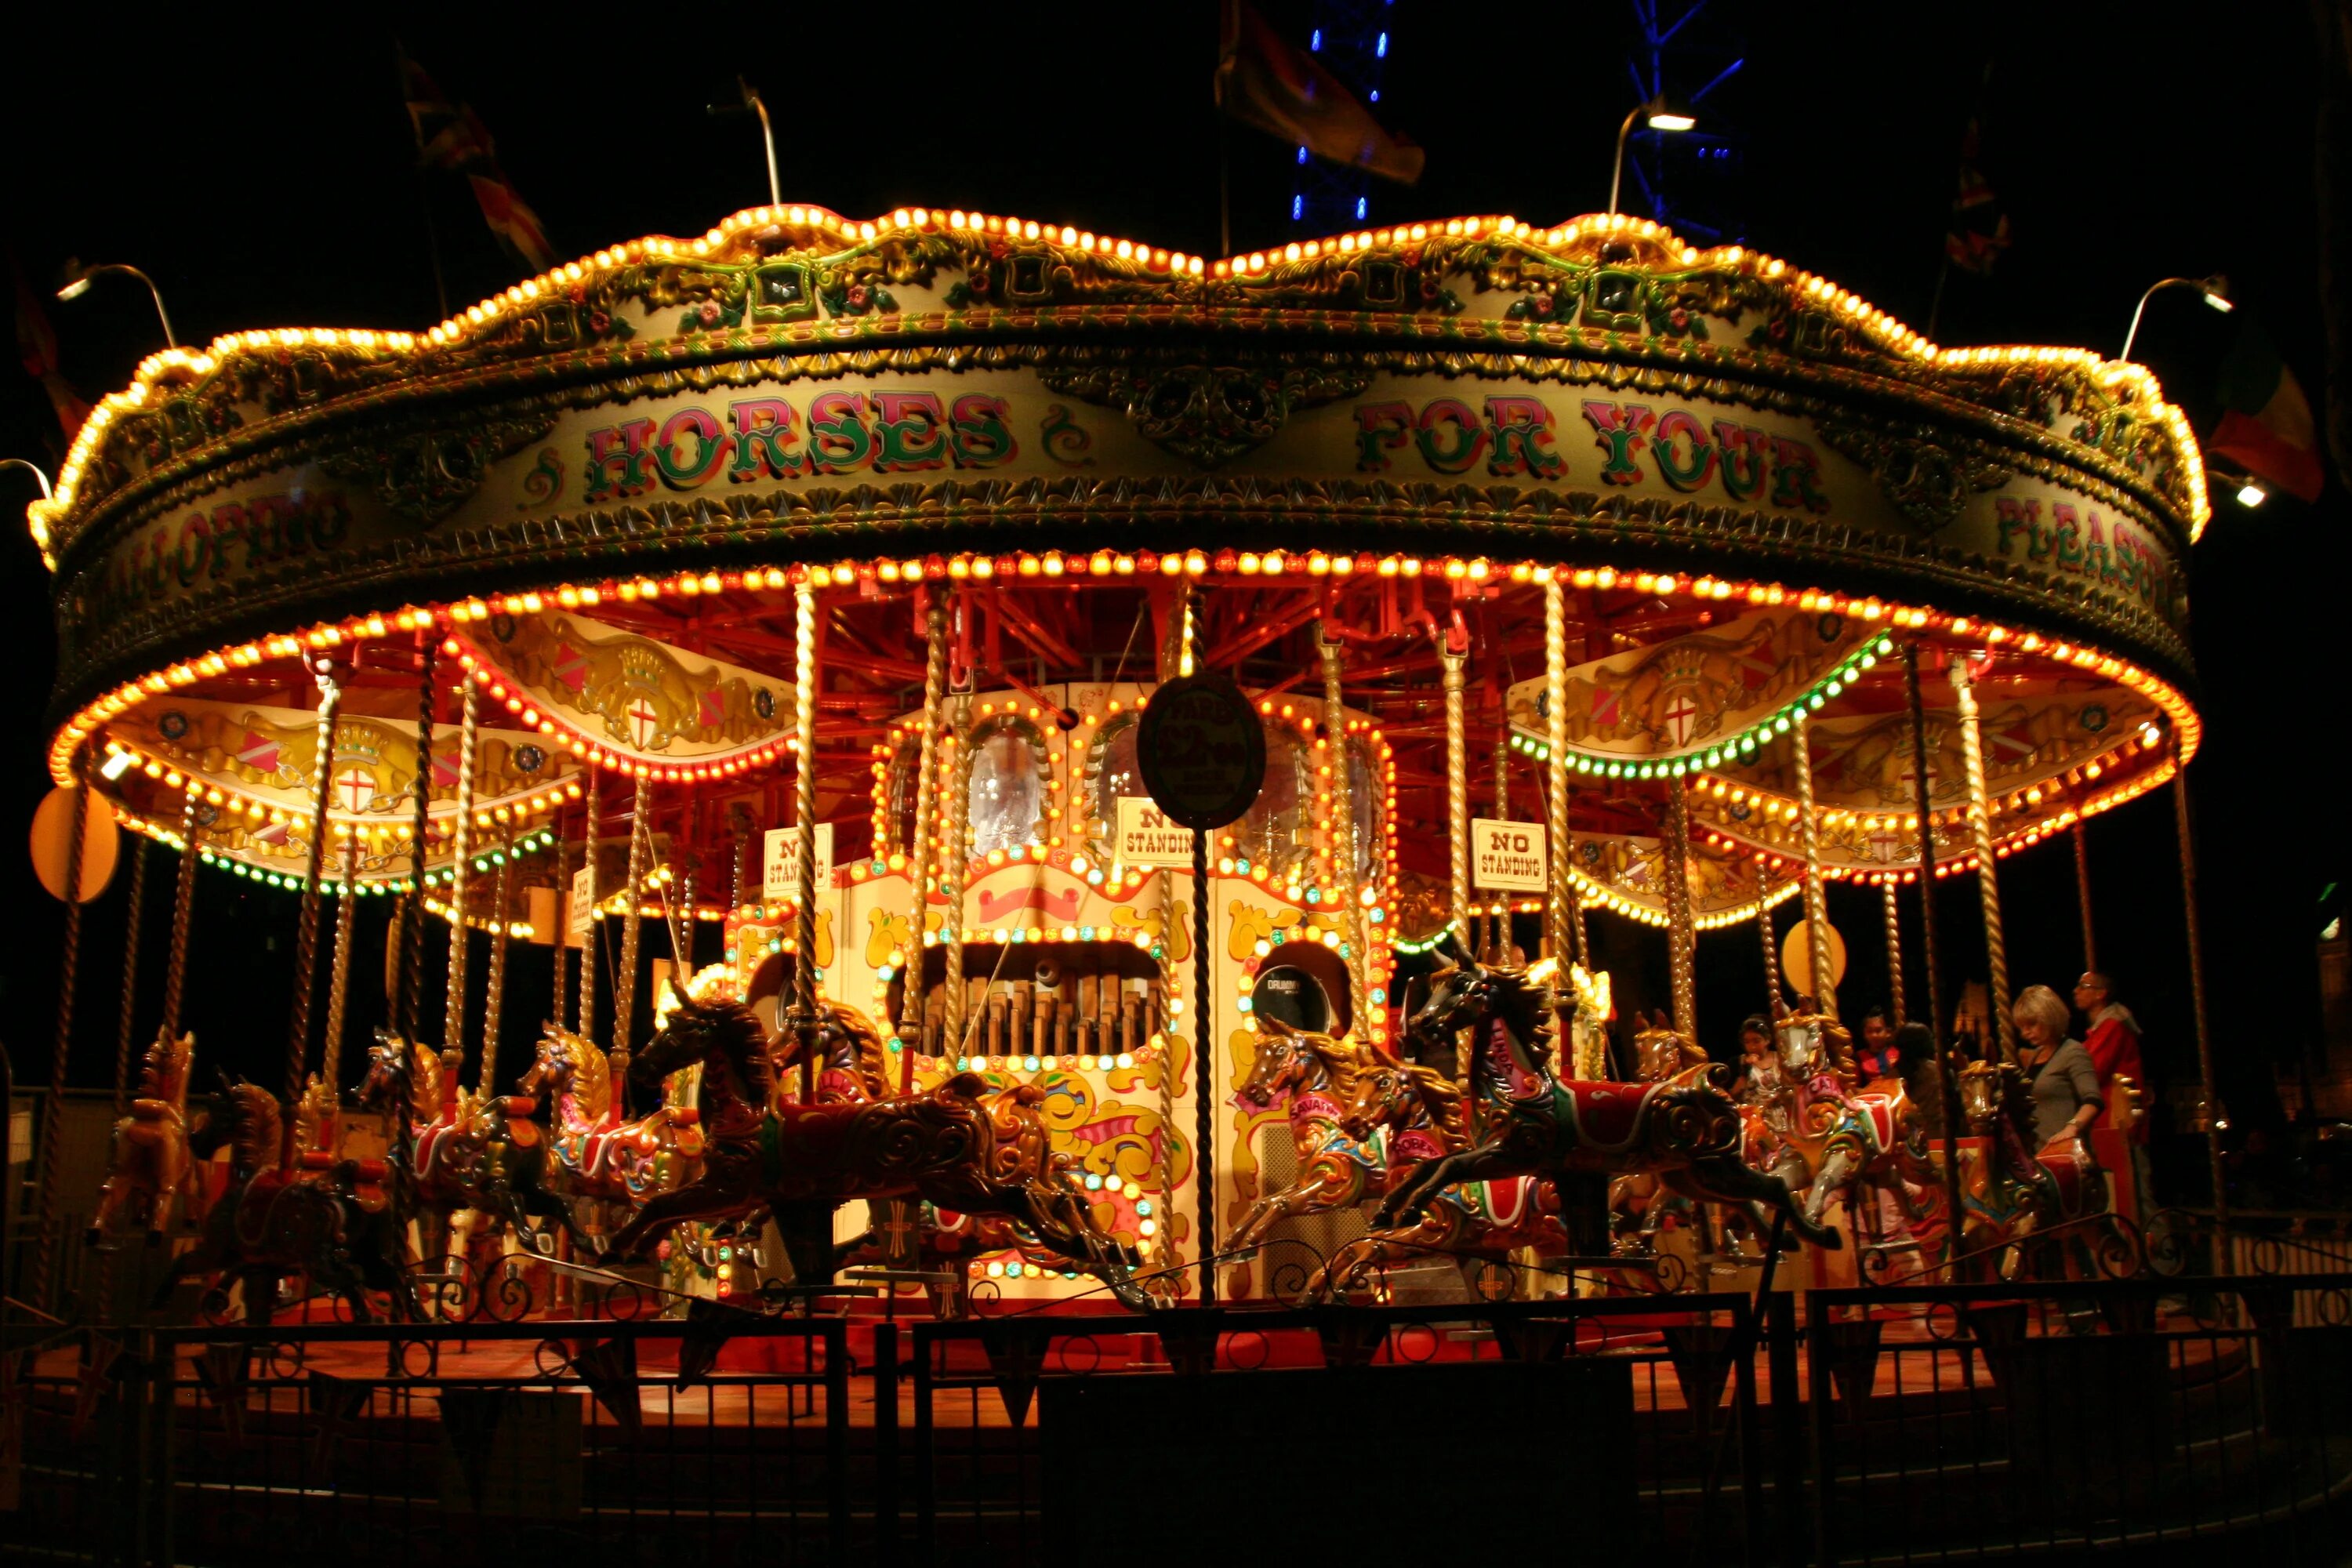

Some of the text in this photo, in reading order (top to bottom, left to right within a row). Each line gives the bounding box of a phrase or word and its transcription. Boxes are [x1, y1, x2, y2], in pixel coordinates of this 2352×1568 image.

[583, 390, 1019, 503] HORSES
[1354, 394, 1831, 514] FOR YOUR
[1127, 832, 1196, 854] STANDIN
[1490, 831, 1530, 853] NO
[769, 858, 824, 884] STANG
[1481, 854, 1540, 877] STANDING
